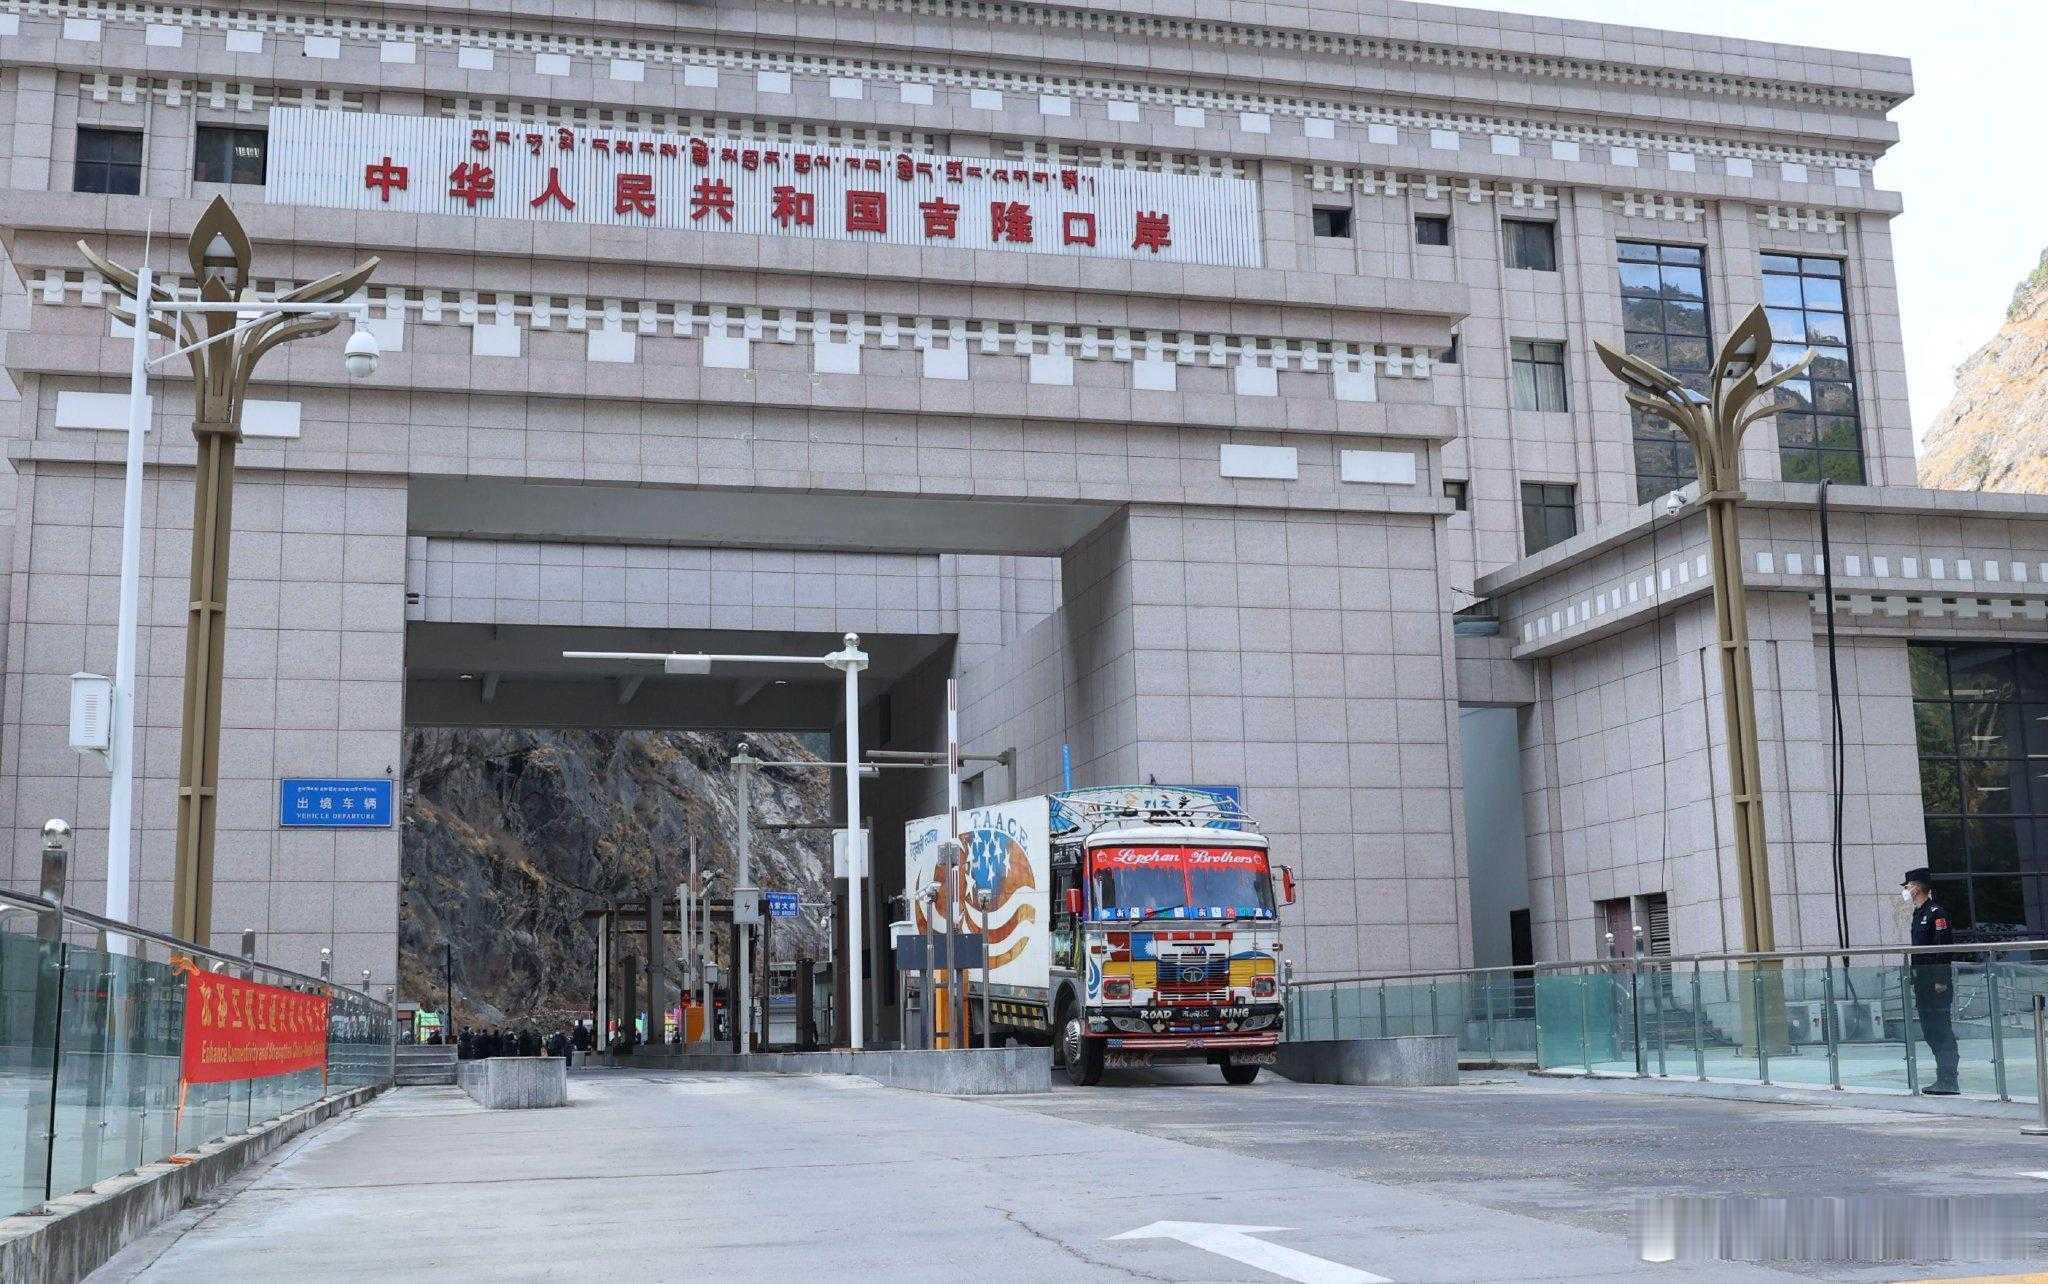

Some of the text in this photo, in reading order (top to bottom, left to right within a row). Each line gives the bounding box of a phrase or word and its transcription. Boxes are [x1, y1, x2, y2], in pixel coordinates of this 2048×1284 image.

[365, 156, 1172, 254] 中华人民共和国吉隆口岸
[297, 797, 377, 810] 出境车辆
[296, 812, 375, 820] VEHICLE DEPARTURE
[1189, 851, 1253, 864] Brothers
[1140, 1010, 1173, 1019] ROAD
[1220, 1007, 1250, 1019] KING
